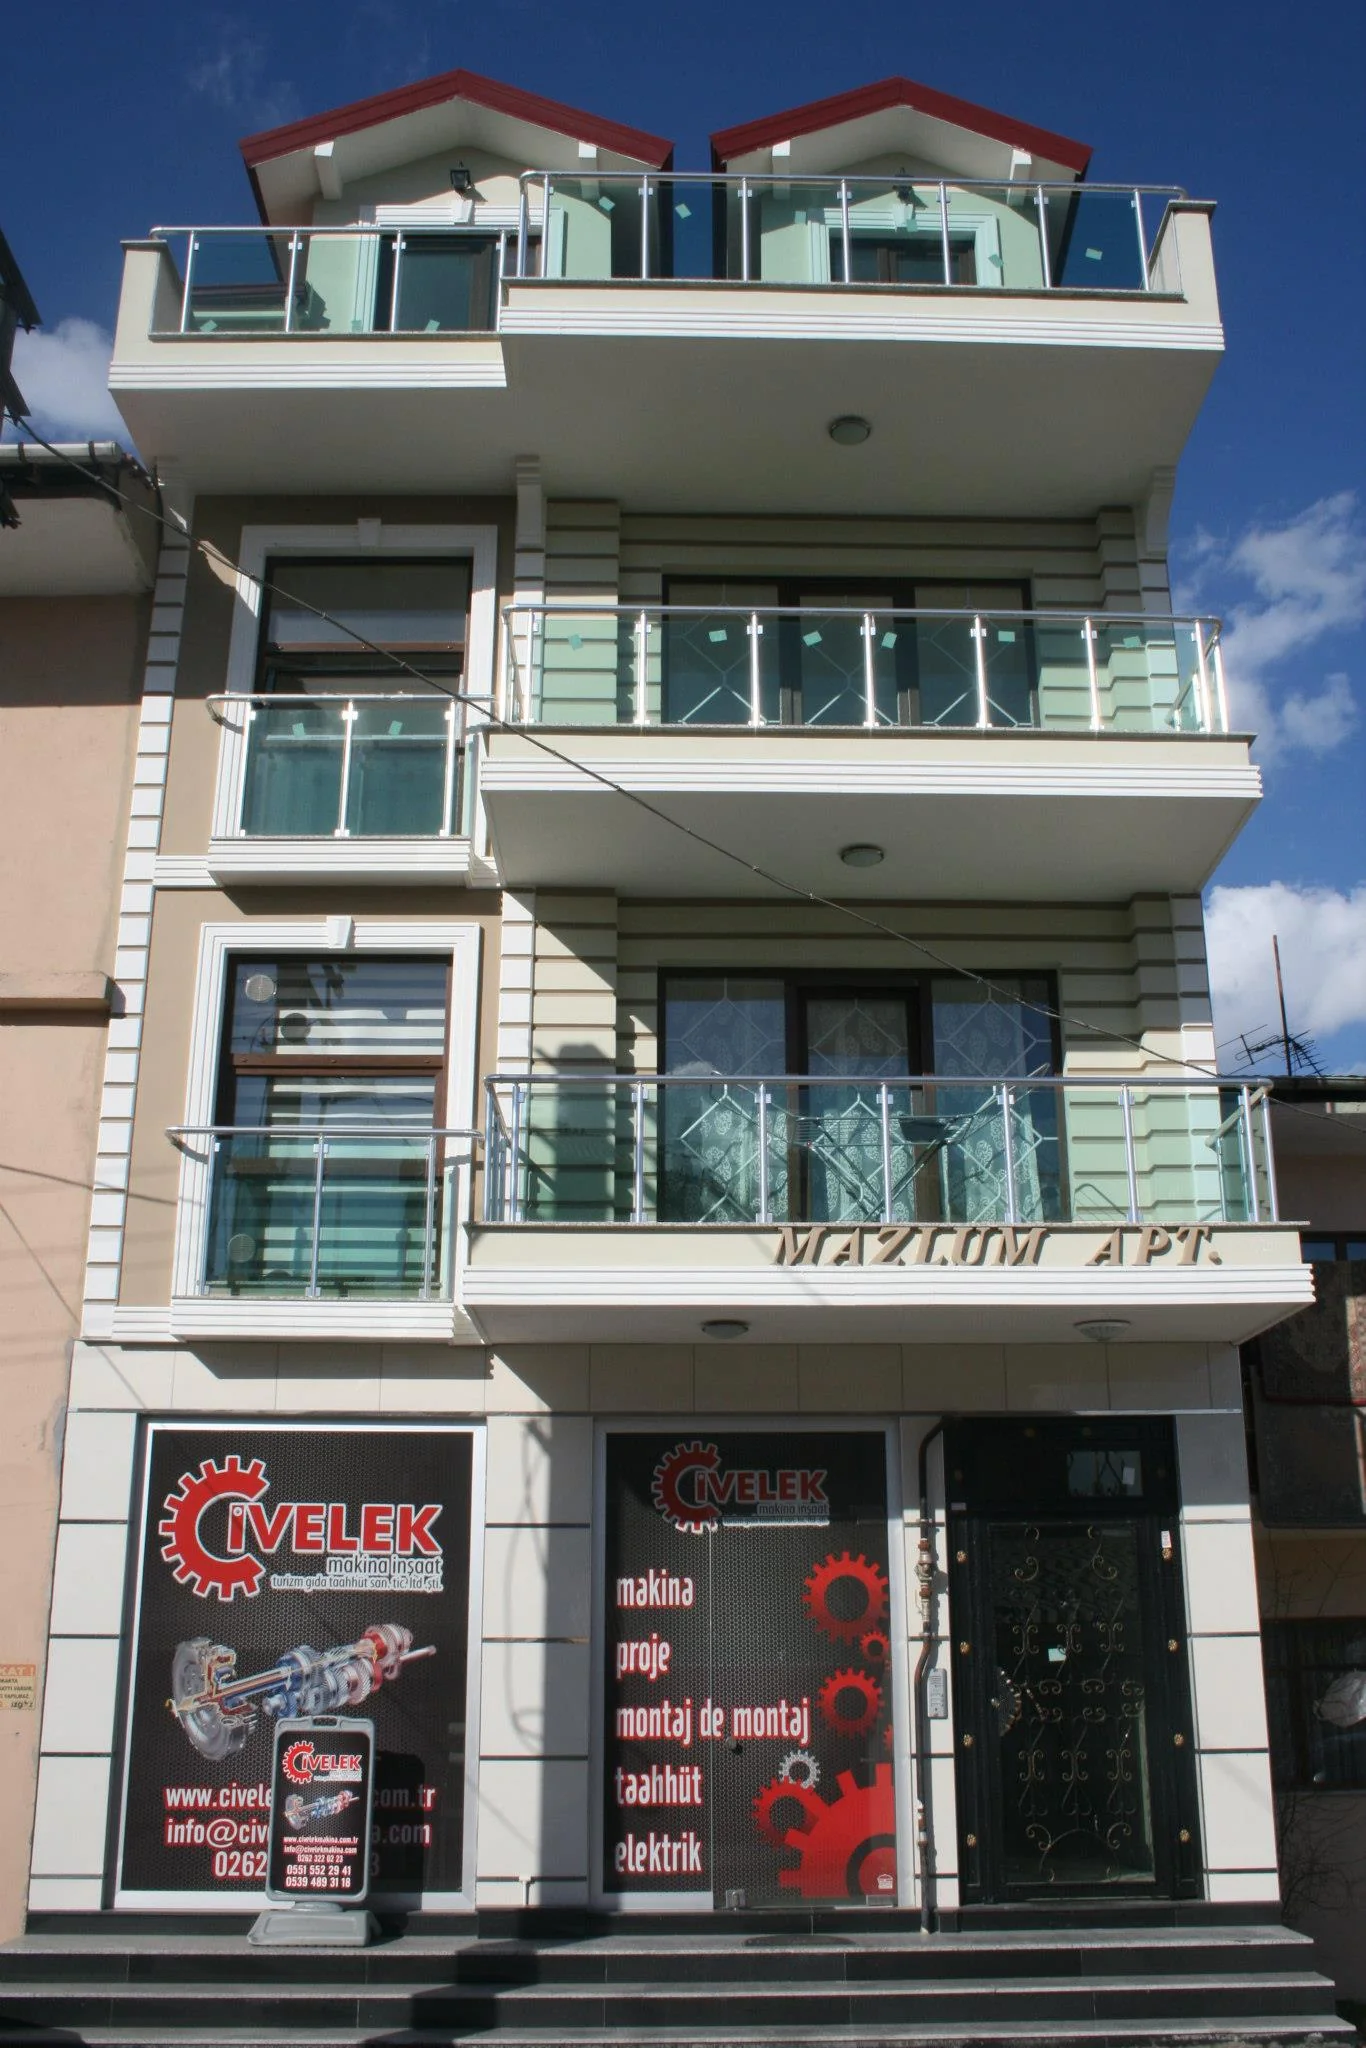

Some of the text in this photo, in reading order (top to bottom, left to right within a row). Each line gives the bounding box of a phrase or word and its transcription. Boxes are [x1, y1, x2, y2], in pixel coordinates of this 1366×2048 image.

[774, 1226, 1224, 1267] MAZLUM APT.
[272, 1577, 303, 1588] turizm
[328, 1554, 441, 1576] makina inşaat
[616, 1569, 694, 1607] makina
[616, 1633, 670, 1679] proje
[616, 1697, 810, 1745] montaj de montaj
[615, 1765, 702, 1805] taahhüt
[215, 1851, 268, 1877] 0262
[287, 1864, 352, 1876] 0551 552 29 41
[615, 1832, 702, 1872] elektrik
[285, 1876, 351, 1888] 0539 489 31 18
